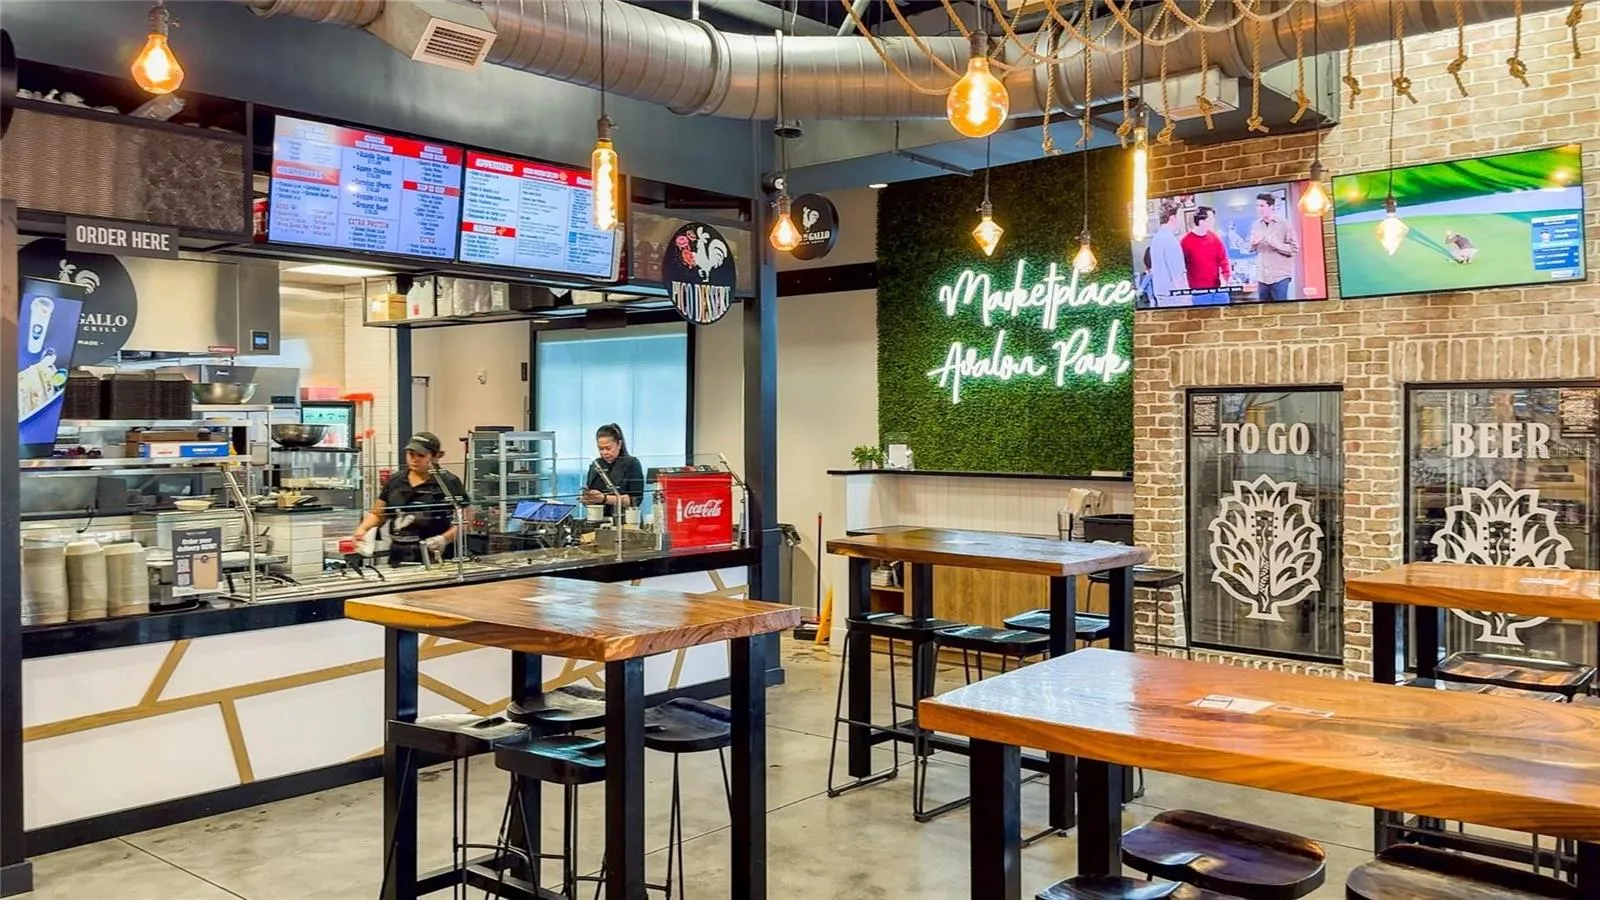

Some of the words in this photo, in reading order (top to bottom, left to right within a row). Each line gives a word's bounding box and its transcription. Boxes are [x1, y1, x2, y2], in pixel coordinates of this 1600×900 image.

[76, 224, 127, 248] ORDER
[131, 231, 170, 251] HERE
[808, 231, 830, 241] GALLO
[672, 281, 694, 320] PICO
[695, 284, 731, 323] DESSERT
[939, 258, 1136, 330] Marketplace
[927, 329, 1048, 404] Avalon
[1051, 319, 1131, 387] Park
[1222, 422, 1260, 454] TO
[1267, 422, 1310, 455] GO
[1451, 422, 1550, 459] BEER
